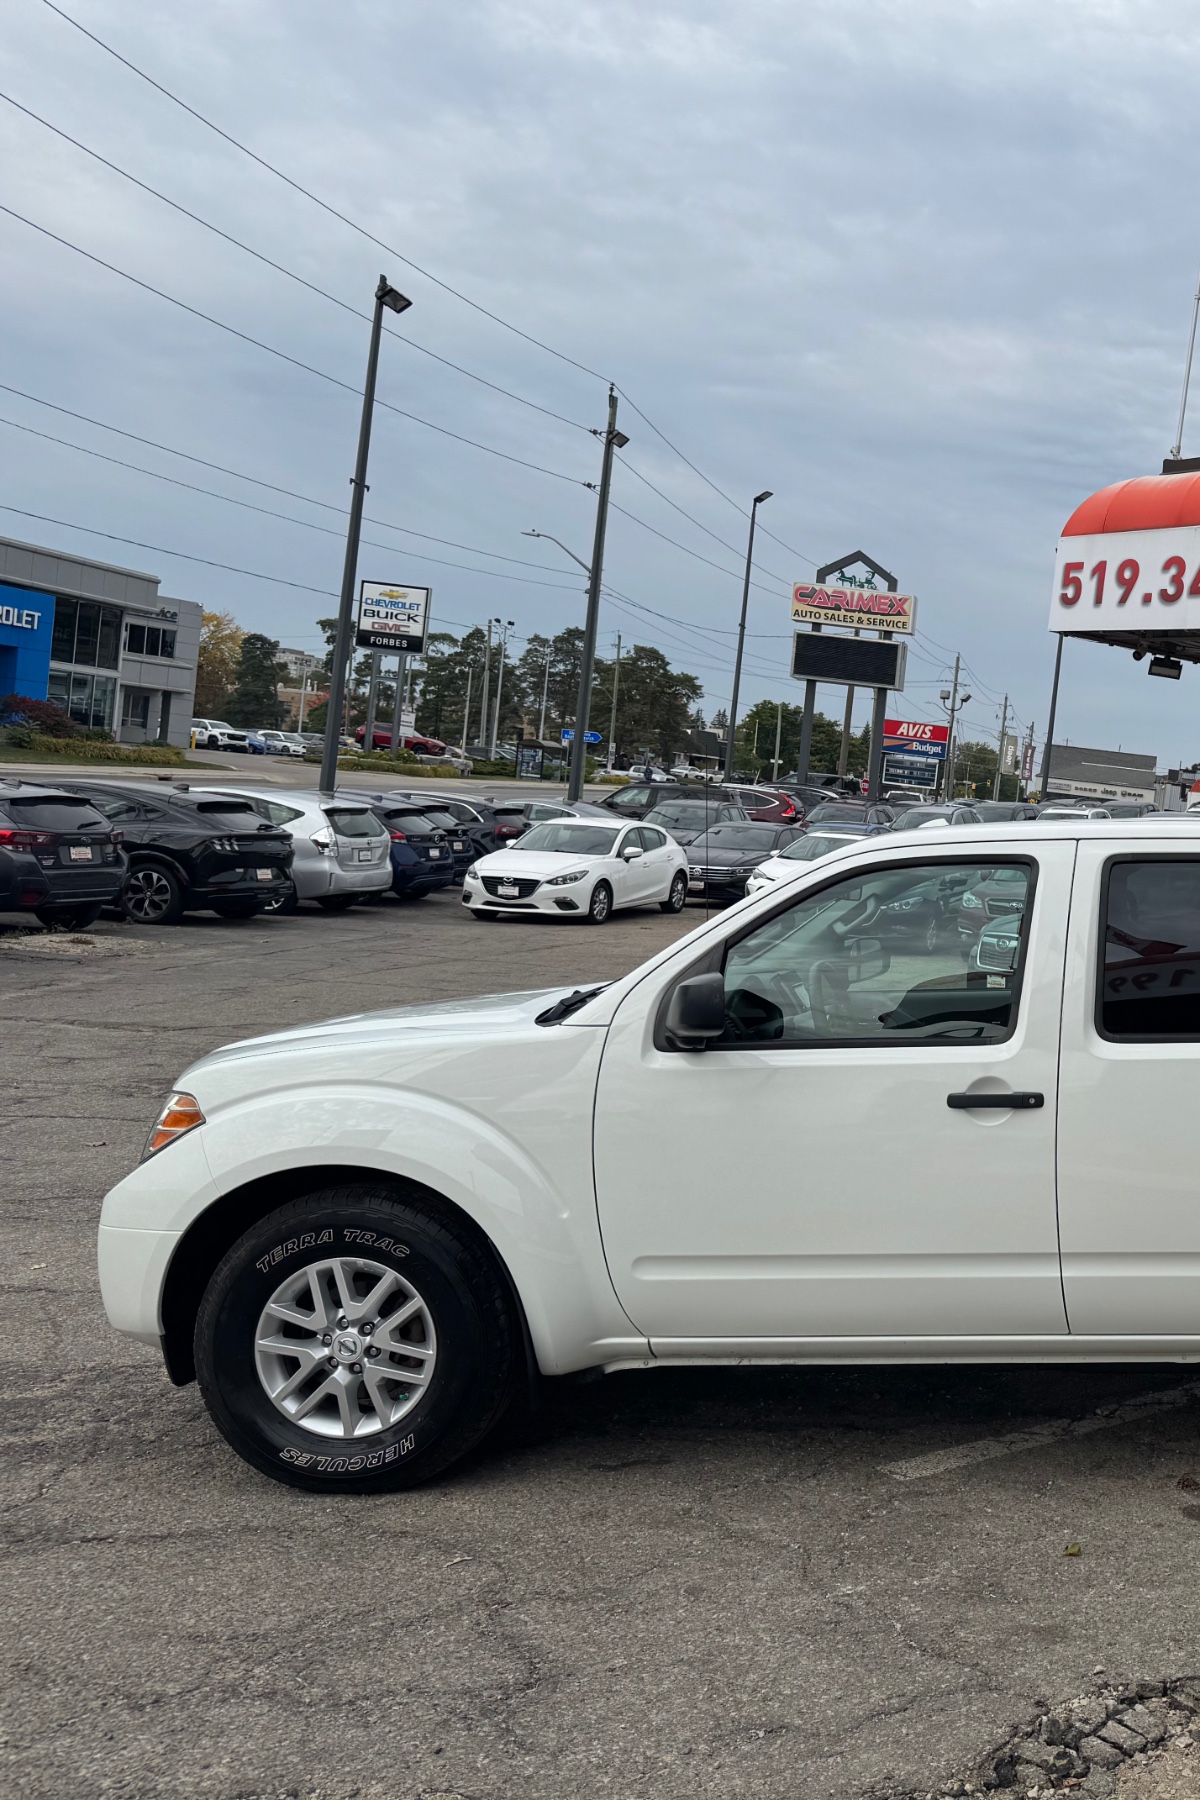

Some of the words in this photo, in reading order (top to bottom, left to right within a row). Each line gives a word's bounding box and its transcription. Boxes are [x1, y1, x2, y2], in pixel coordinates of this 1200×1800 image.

[365, 597, 422, 611] CHEVROLET
[794, 585, 910, 616] CARIMEX
[363, 608, 420, 624] BUICK
[793, 609, 821, 620] AUTO
[824, 612, 855, 624] SALES
[857, 616, 865, 625] &
[867, 617, 908, 630] SERVICE
[371, 621, 411, 634] GMC
[370, 636, 408, 648] FORBES
[896, 722, 933, 739] AVIS
[912, 741, 942, 755] Budget
[1005, 745, 1015, 766] Jeep
[1101, 787, 1118, 797] Jeep
[256, 1229, 334, 1273] TERRA
[343, 1229, 410, 1258] TRAC
[279, 1433, 415, 1473] HERCULES
